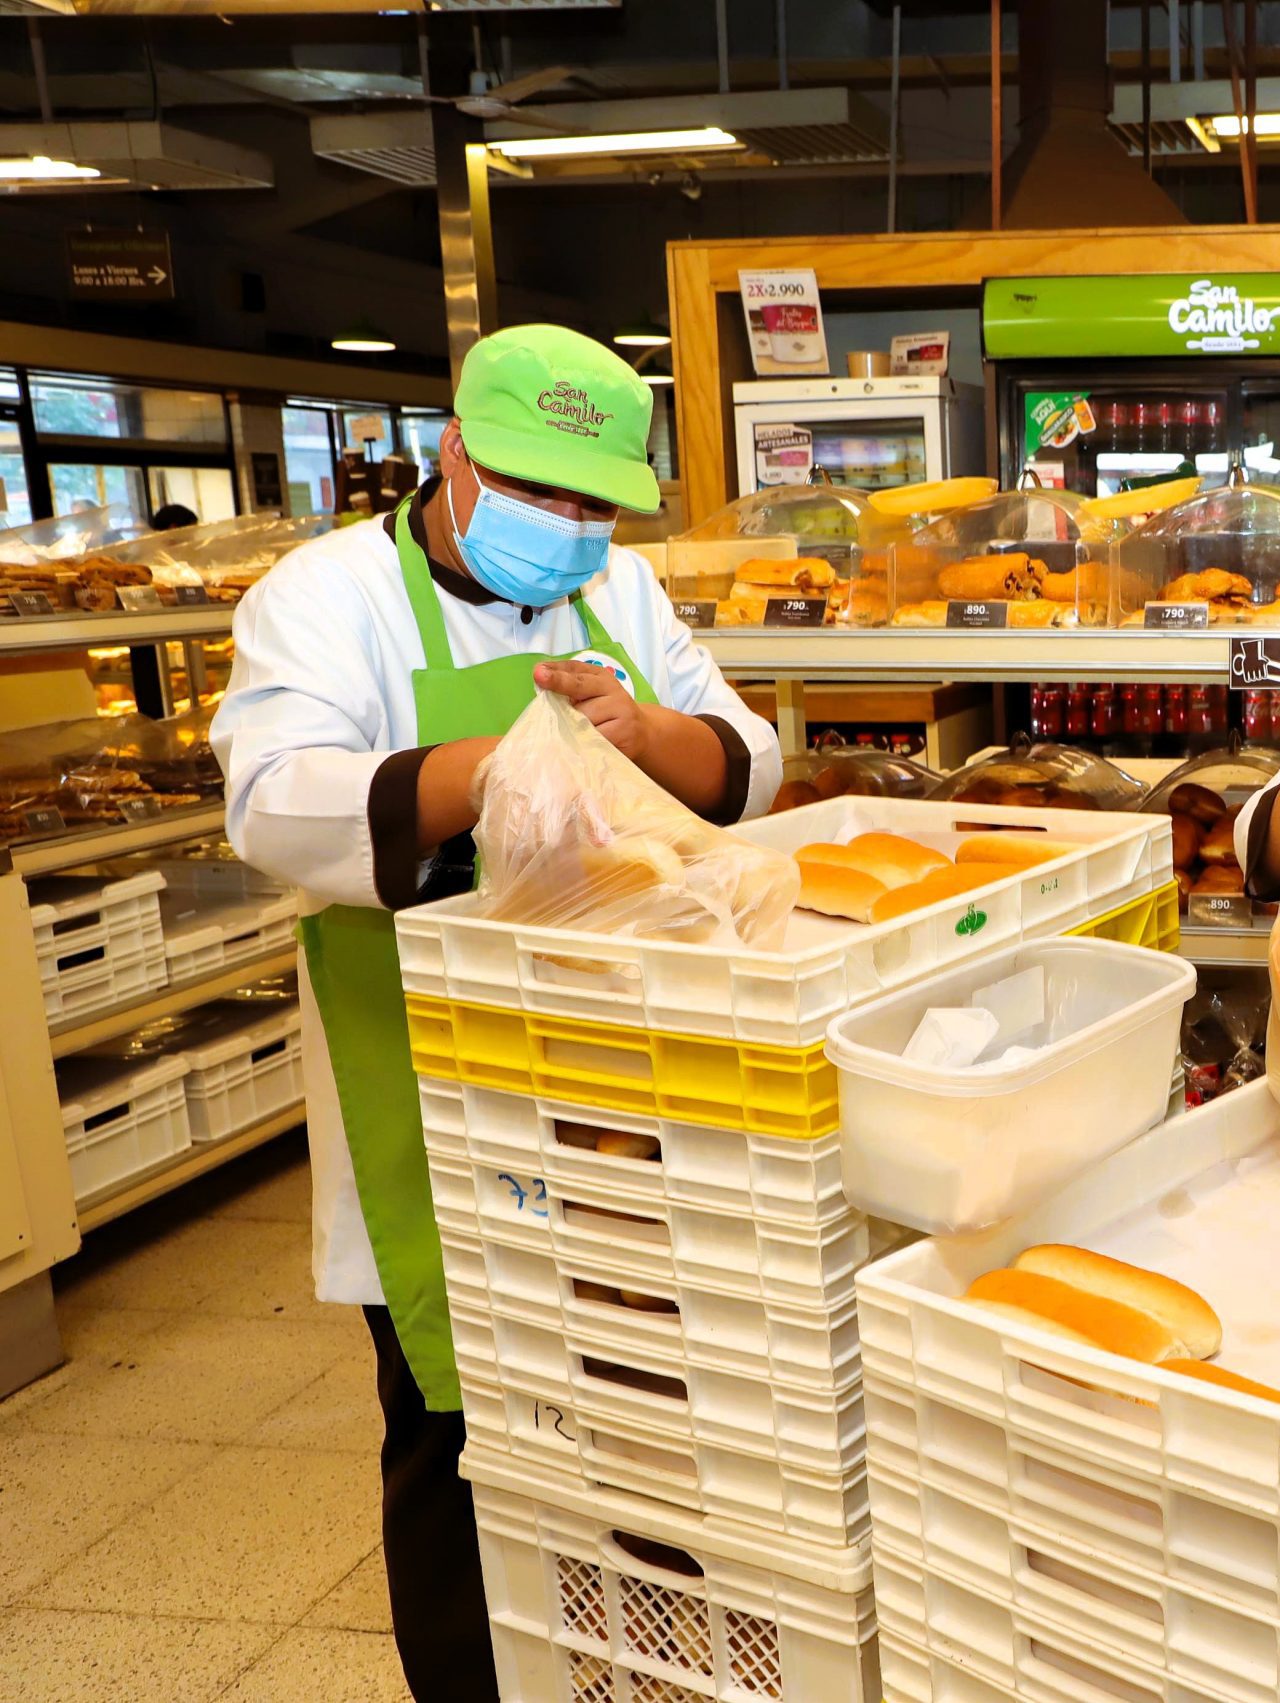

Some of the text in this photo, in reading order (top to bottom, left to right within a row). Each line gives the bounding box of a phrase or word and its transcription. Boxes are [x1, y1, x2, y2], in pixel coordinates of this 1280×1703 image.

[1188, 279, 1241, 309] San
[553, 381, 588, 403] San
[538, 390, 614, 426] Camilo
